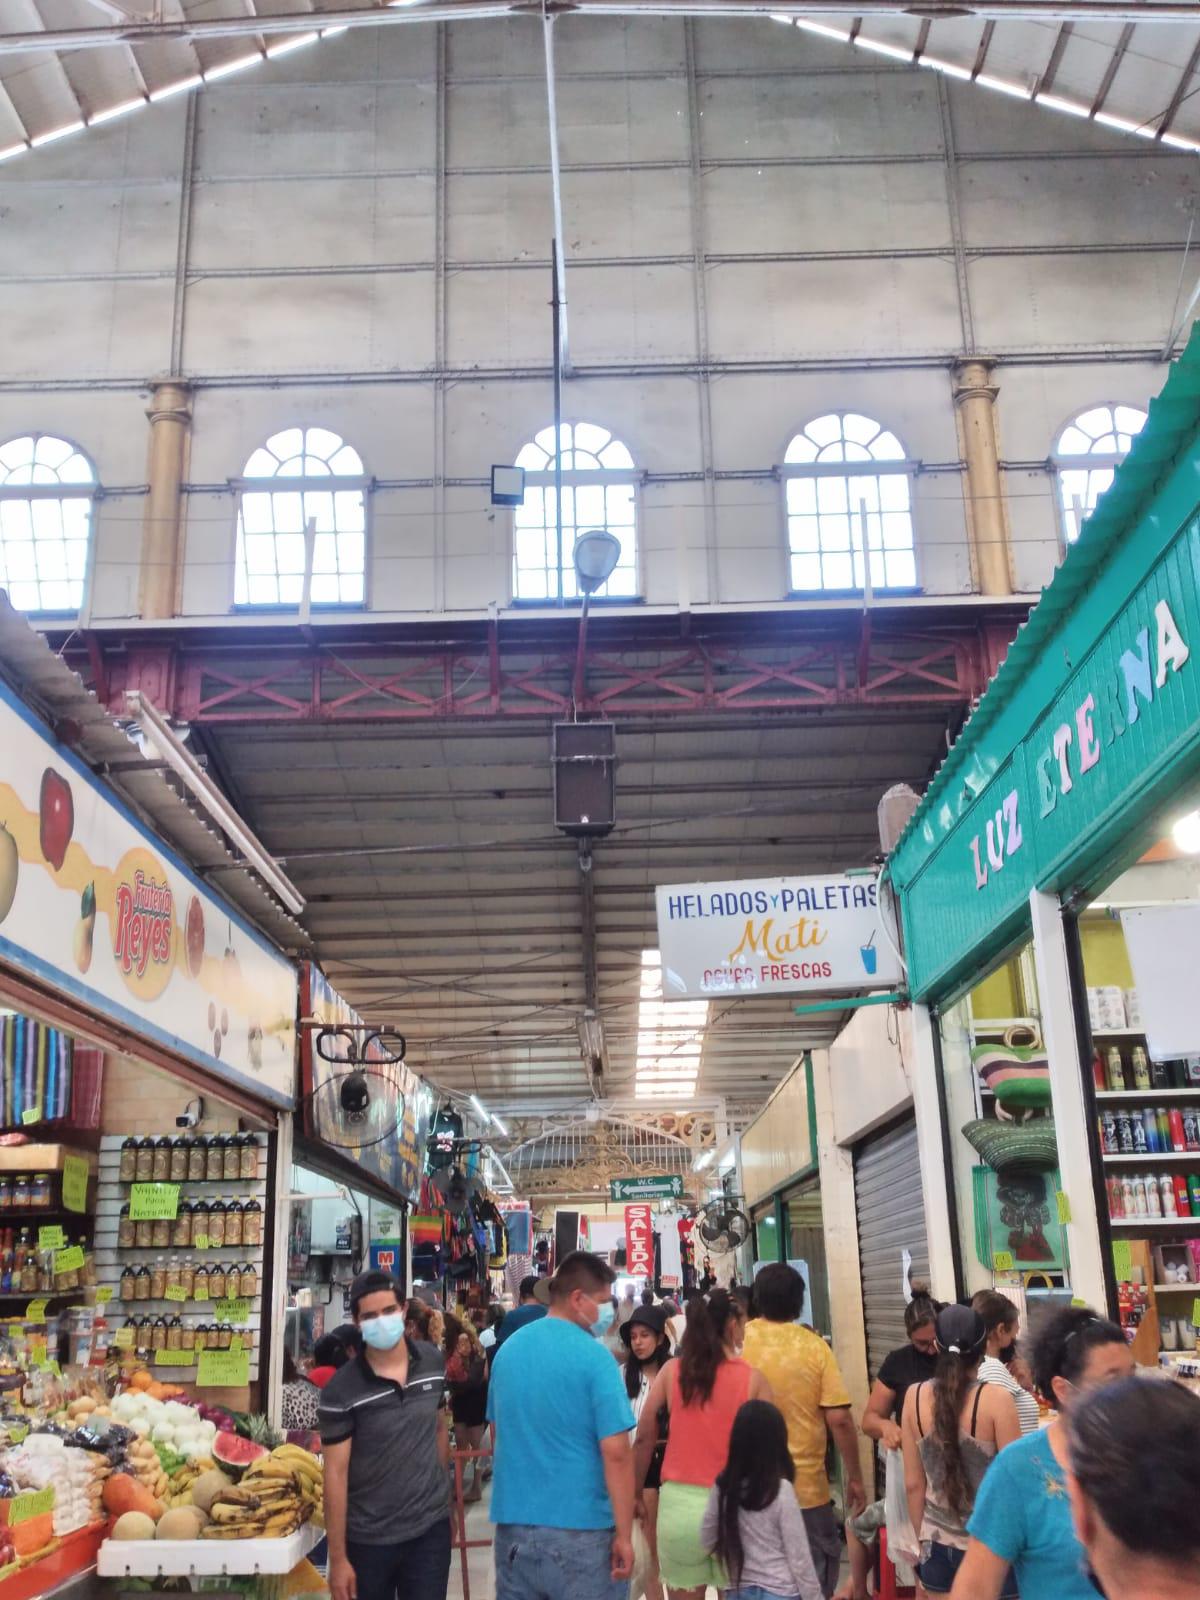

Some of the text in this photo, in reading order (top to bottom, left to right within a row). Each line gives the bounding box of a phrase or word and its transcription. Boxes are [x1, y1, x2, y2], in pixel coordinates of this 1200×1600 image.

[970, 599, 1189, 890] LUZ ETERNA
[115, 882, 171, 977] Reyes
[669, 883, 877, 920] HELADOS Y PALETAS
[728, 917, 829, 963] Mati
[761, 961, 832, 982] FRESCAS
[629, 1207, 649, 1273] SALIDA
